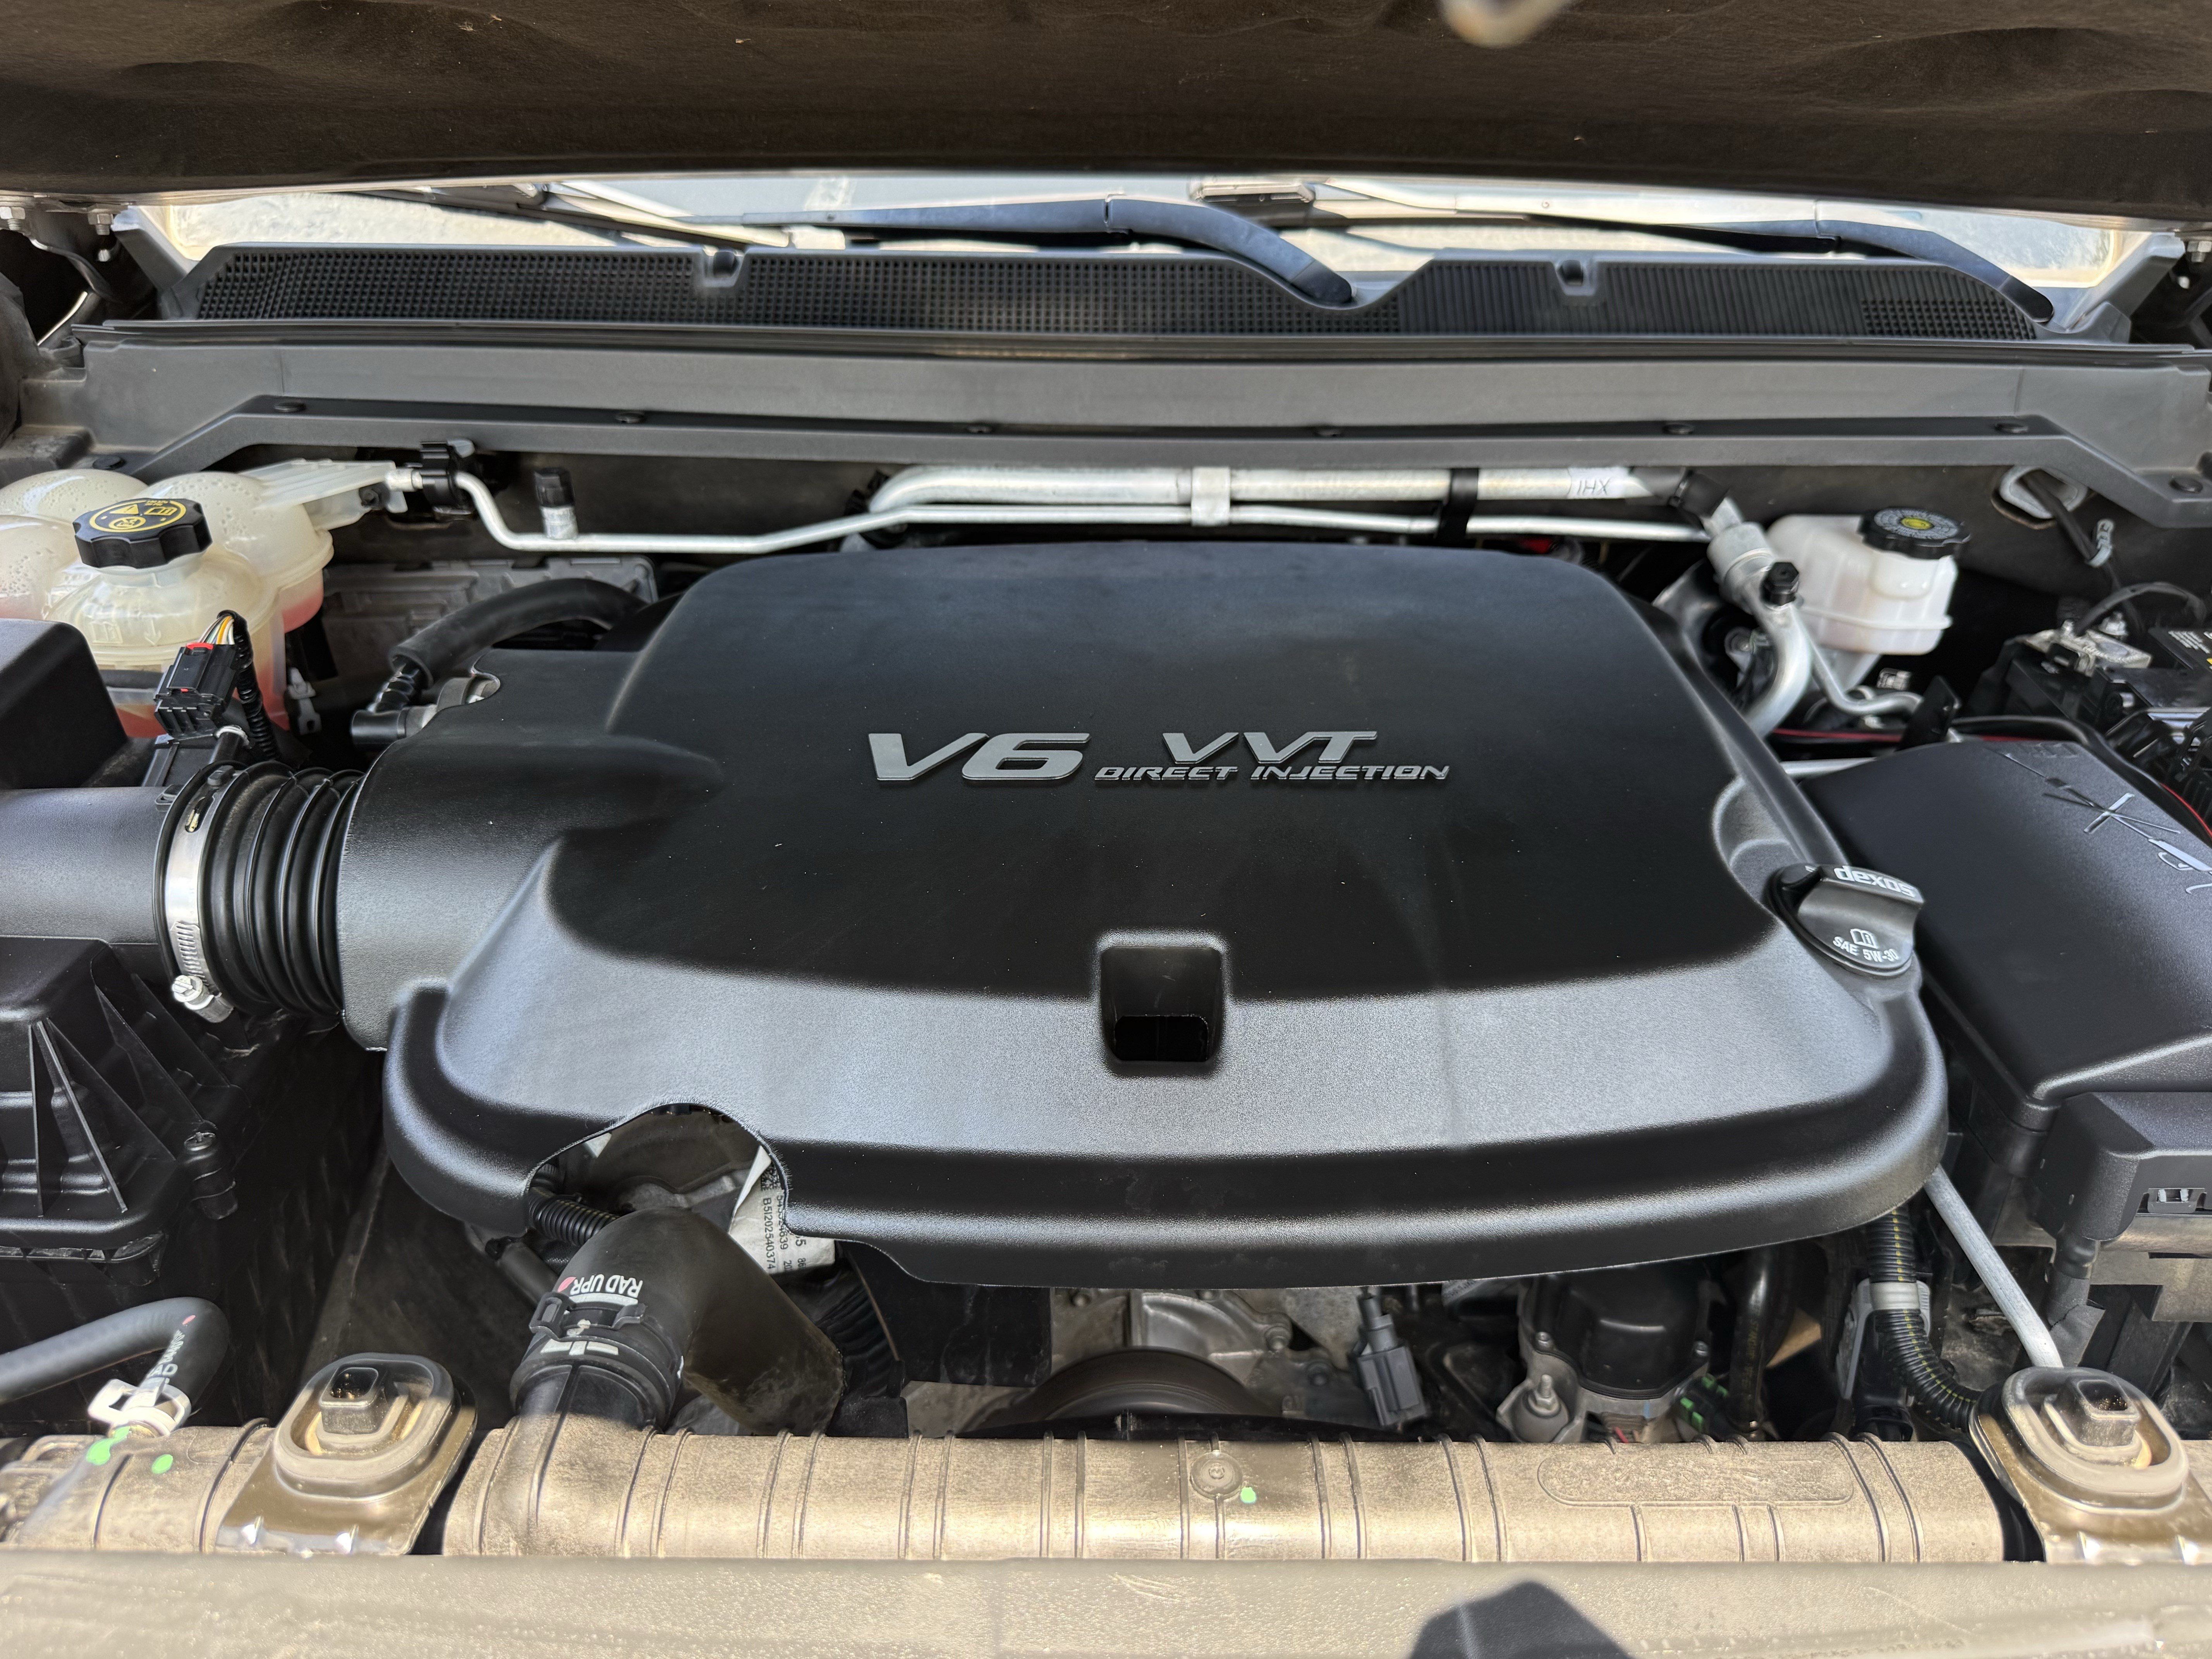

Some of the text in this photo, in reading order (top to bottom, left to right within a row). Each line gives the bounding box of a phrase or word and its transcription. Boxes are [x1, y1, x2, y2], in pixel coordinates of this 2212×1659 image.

[868, 730, 1377, 781] V6 VVT
[1094, 765, 1450, 781] DIRECT INJECTION
[1833, 865, 1917, 898] dexos
[1832, 936, 1899, 963] SAE 5W-30
[570, 1274, 643, 1298] RAD UPR
